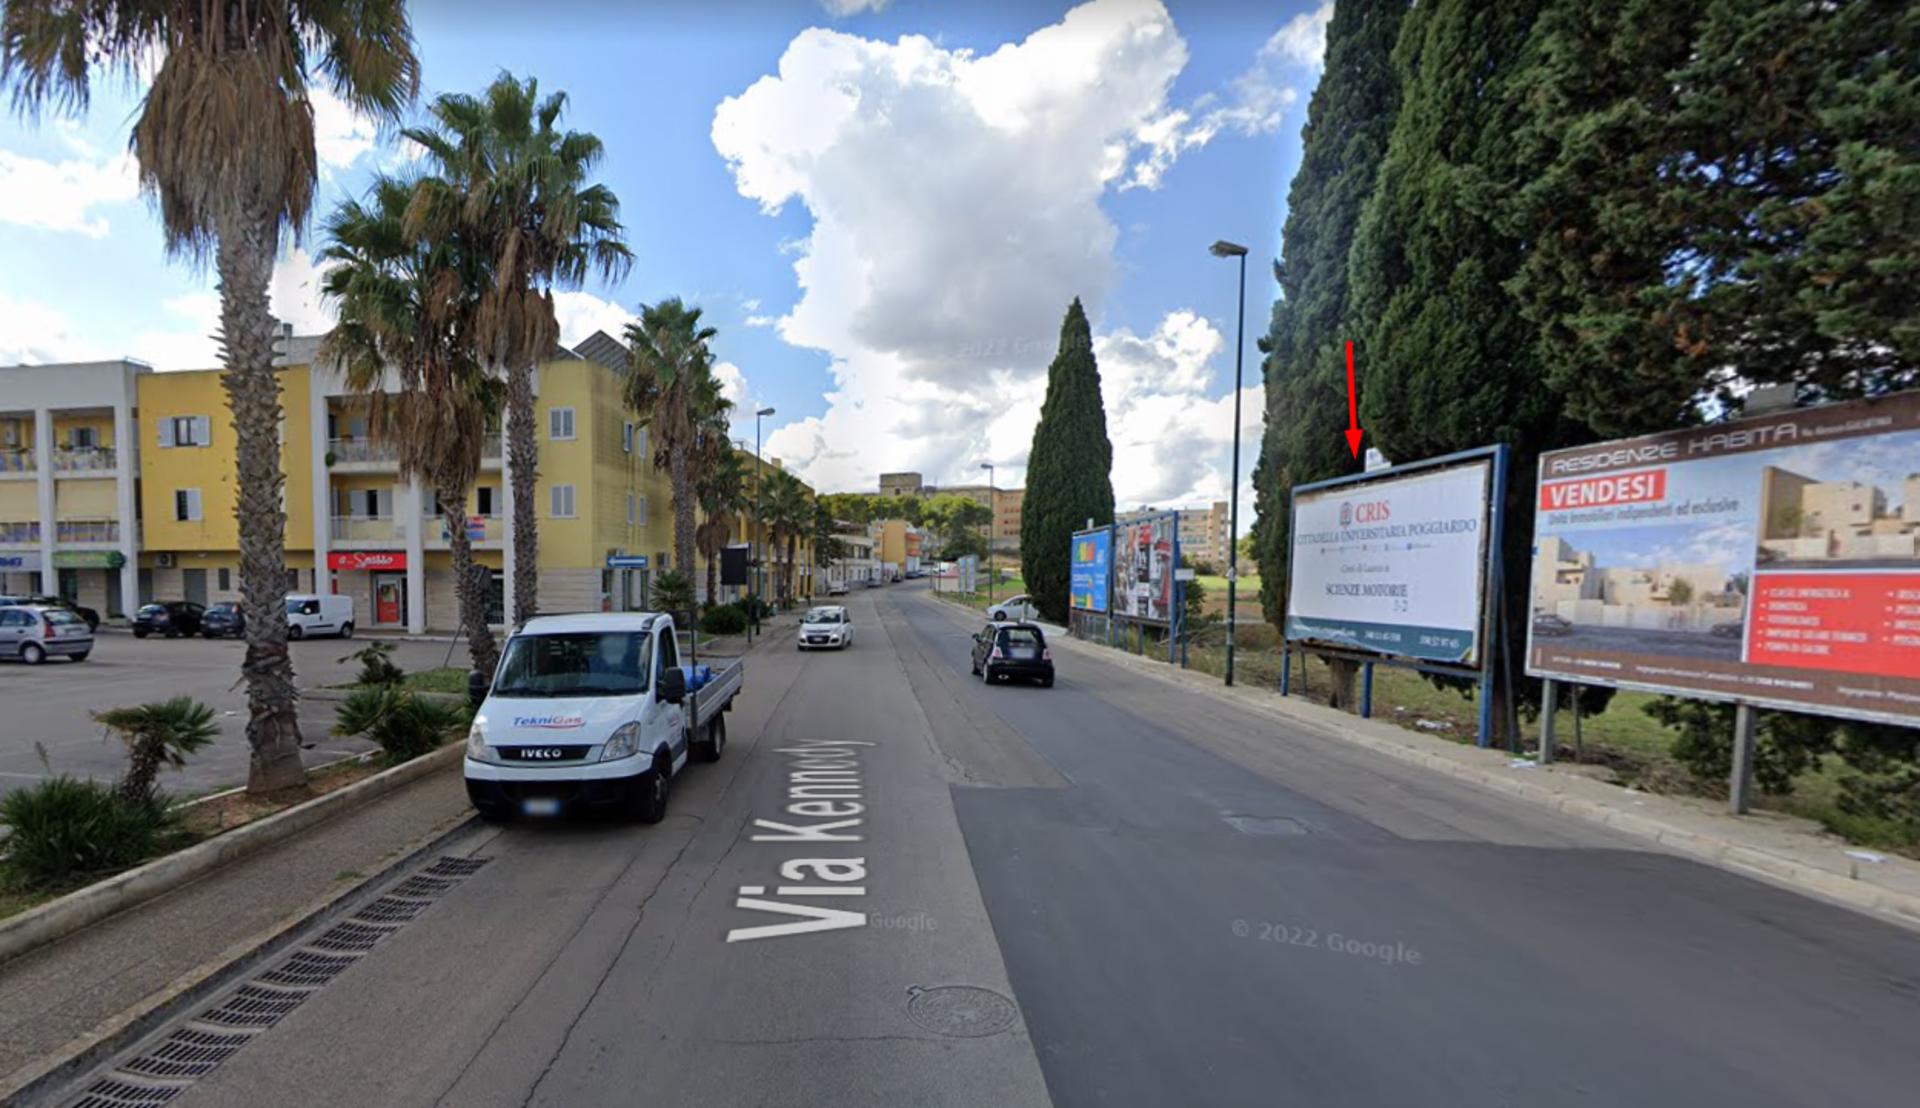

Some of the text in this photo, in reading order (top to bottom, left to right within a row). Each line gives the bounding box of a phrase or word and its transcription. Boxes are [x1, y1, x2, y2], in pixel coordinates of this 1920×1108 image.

[1551, 441, 1677, 473] RESIDENZE
[1689, 422, 1797, 454] HABITA
[1551, 474, 1656, 507] VENDESI
[1355, 500, 1390, 523] CRIS
[1676, 499, 1690, 516] ed
[1692, 497, 1740, 515] esclusive
[1341, 526, 1407, 543] UNIVERSITARIA
[1408, 519, 1477, 537] POGGIARDO
[1325, 583, 1408, 597] SCIENZE MOTORIE
[513, 715, 584, 728] TekniGas
[521, 749, 562, 758] IVECO
